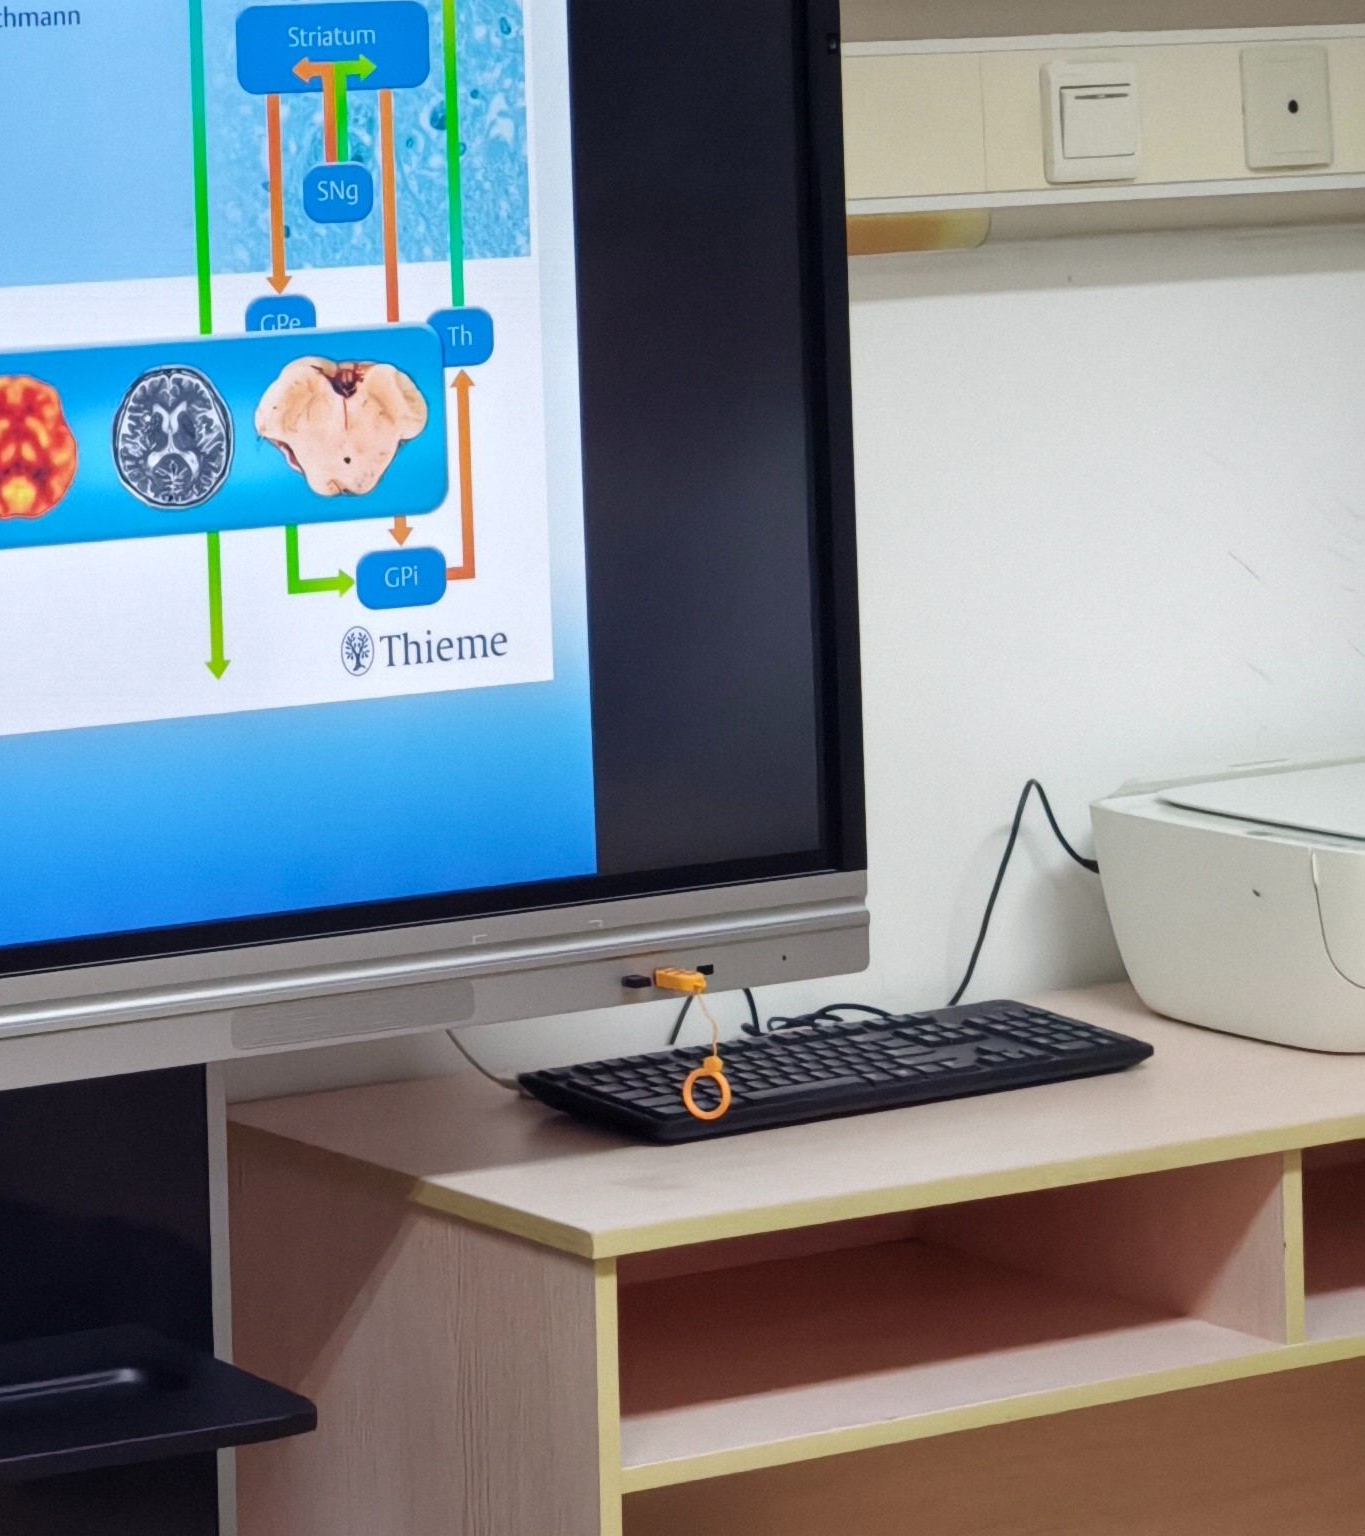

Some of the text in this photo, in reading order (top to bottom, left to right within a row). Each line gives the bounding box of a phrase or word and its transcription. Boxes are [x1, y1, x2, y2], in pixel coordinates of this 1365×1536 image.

[287, 24, 376, 48] Striatum
[316, 180, 359, 206] SNg
[446, 325, 473, 347] Th
[384, 565, 419, 589] GPi
[379, 628, 509, 669] Thieme
